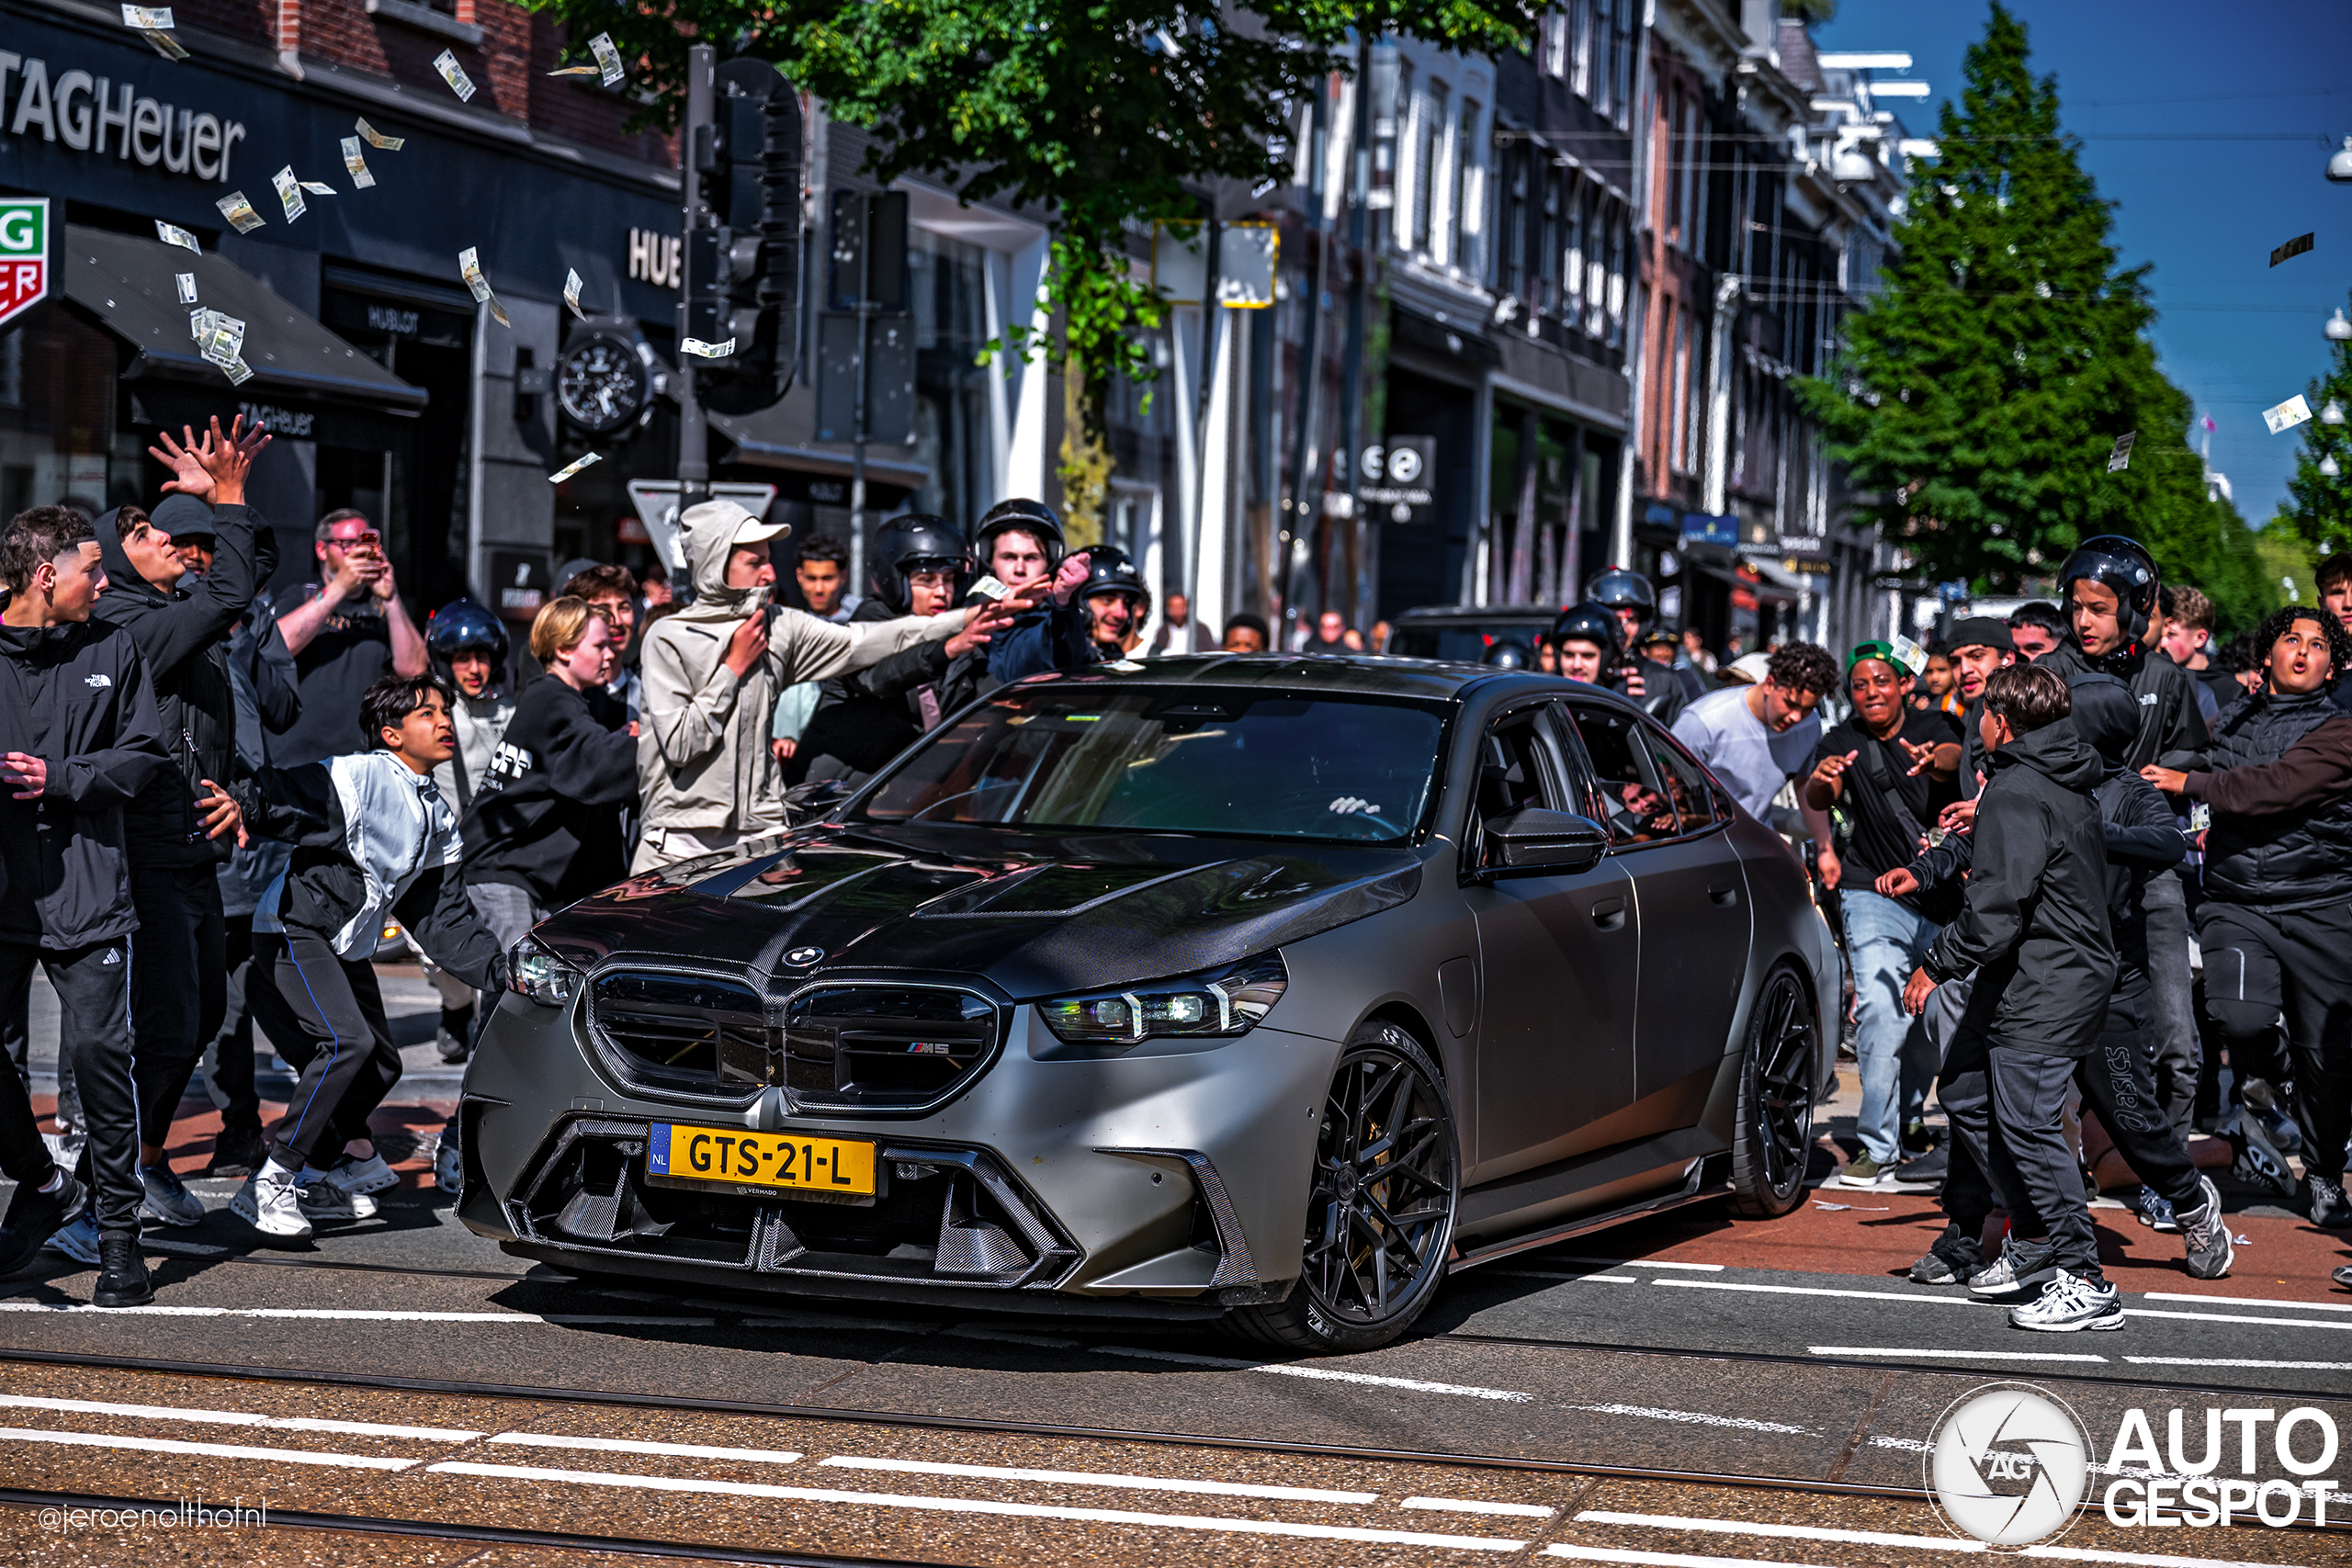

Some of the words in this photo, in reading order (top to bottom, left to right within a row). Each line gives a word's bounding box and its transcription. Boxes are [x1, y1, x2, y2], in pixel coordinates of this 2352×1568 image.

[920, 1043, 949, 1055] M5
[652, 1153, 667, 1166] NL
[689, 1134, 852, 1185] GTS-21-L
[748, 1188, 777, 1196] VERMADO
